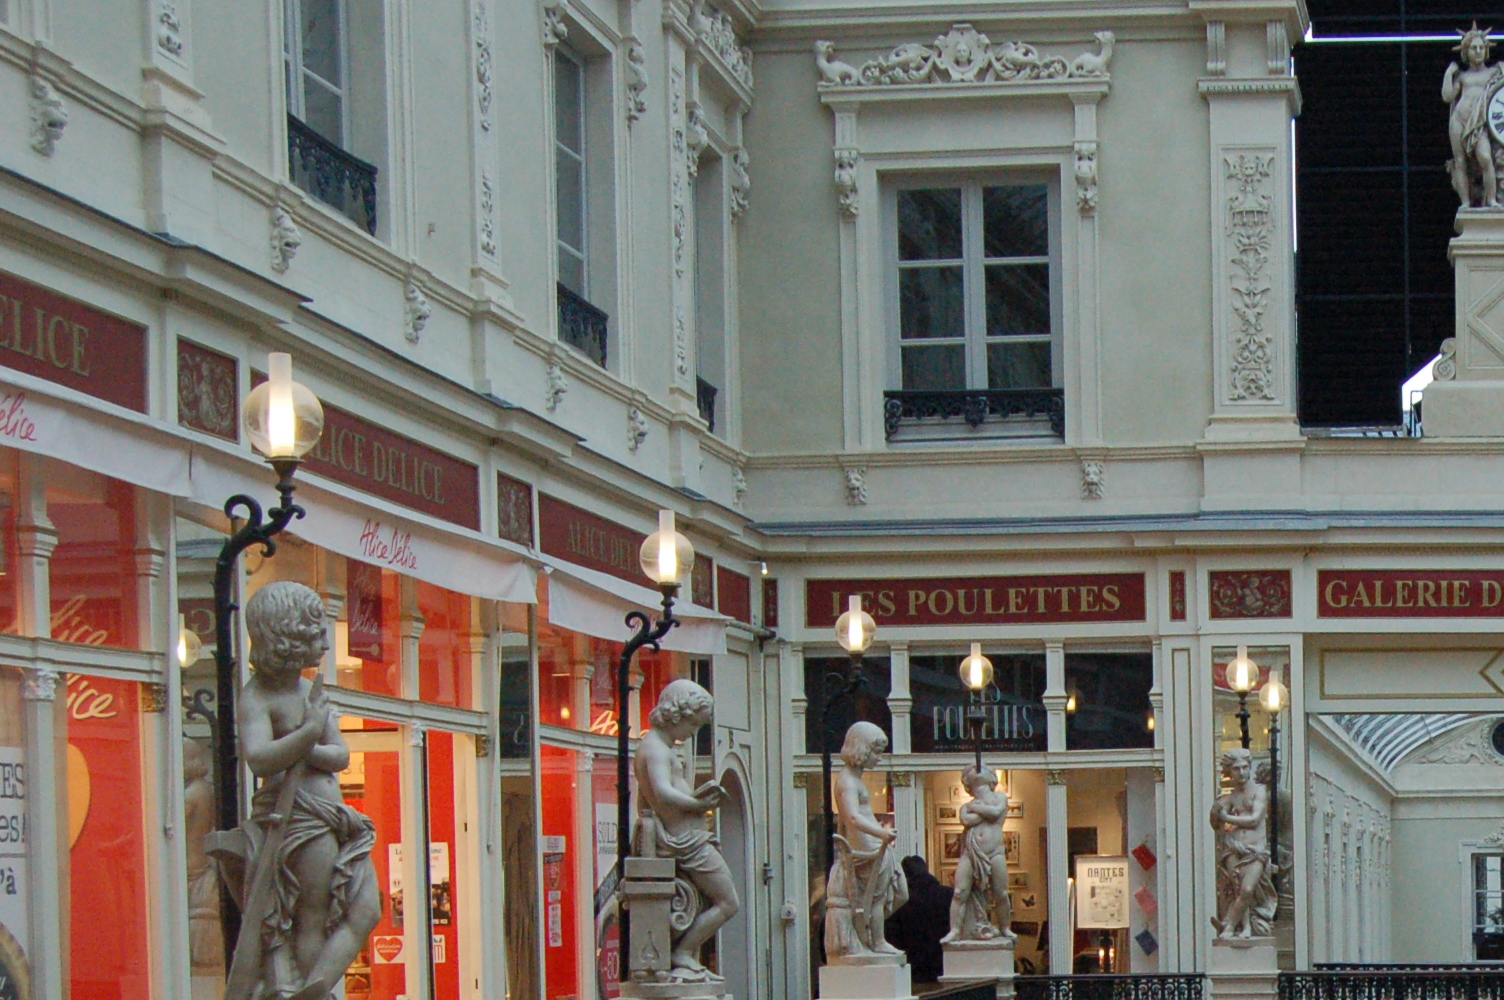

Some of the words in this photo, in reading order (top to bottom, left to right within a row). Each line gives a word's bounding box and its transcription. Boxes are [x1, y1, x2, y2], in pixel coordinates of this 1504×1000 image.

[303, 424, 367, 477] LICE
[373, 441, 446, 505] DELICE
[359, 519, 389, 558] Alice
[832, 589, 896, 617] LES
[906, 585, 1121, 616] POULETTES
[1324, 579, 1472, 608] GALERIE
[1087, 867, 1124, 877] NANTES
